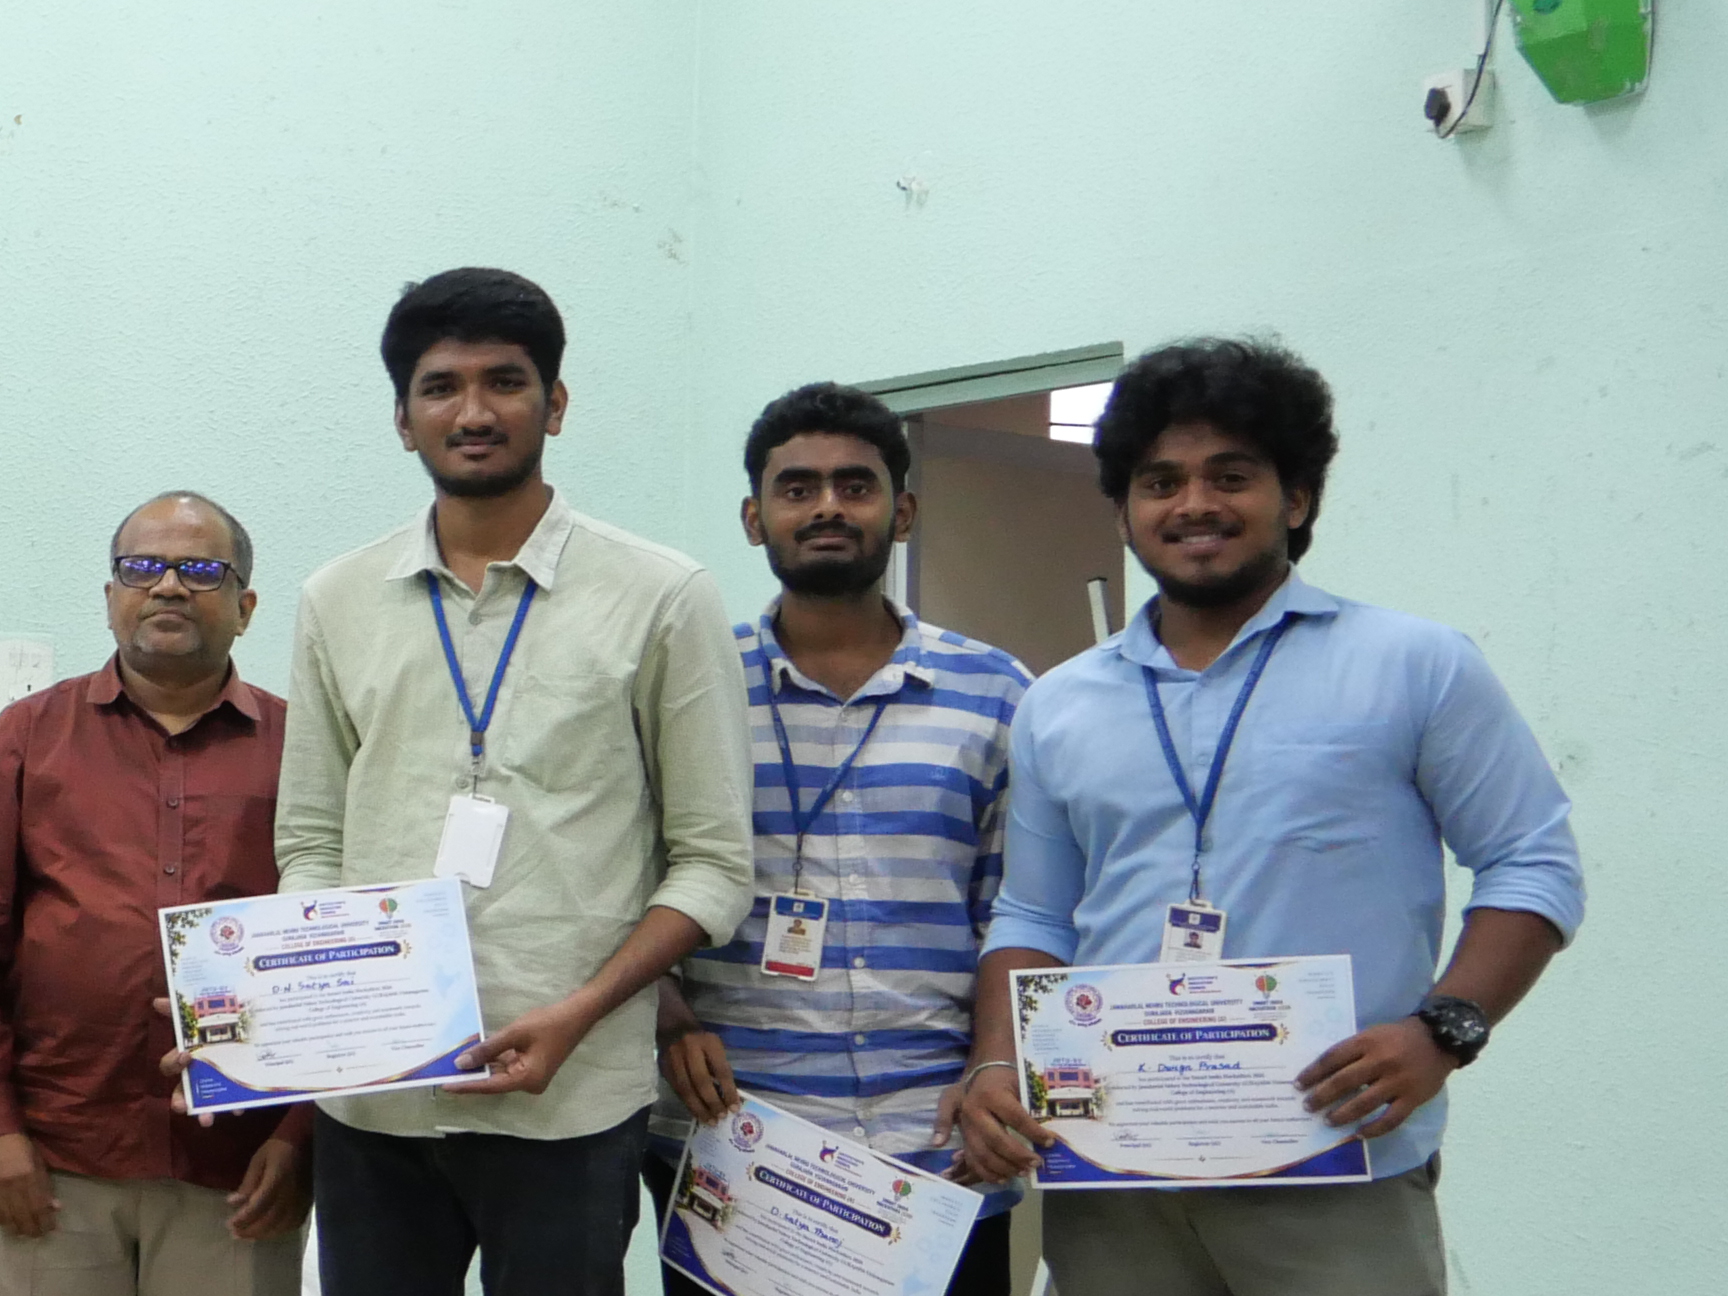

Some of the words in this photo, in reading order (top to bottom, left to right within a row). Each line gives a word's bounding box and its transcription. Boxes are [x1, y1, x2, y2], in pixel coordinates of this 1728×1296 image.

[258, 955, 314, 969] CERTIFICATE
[314, 953, 326, 962] OF
[328, 944, 395, 960] PARTICIPATION
[1117, 1032, 1179, 1044] CERTIFICATE
[1180, 1031, 1193, 1042] OF
[1195, 1028, 1270, 1041] PARTICIPATION
[757, 1168, 810, 1201] CERTIFICATE
[808, 1192, 822, 1205] OF
[820, 1197, 886, 1235] PARTICIPATION
